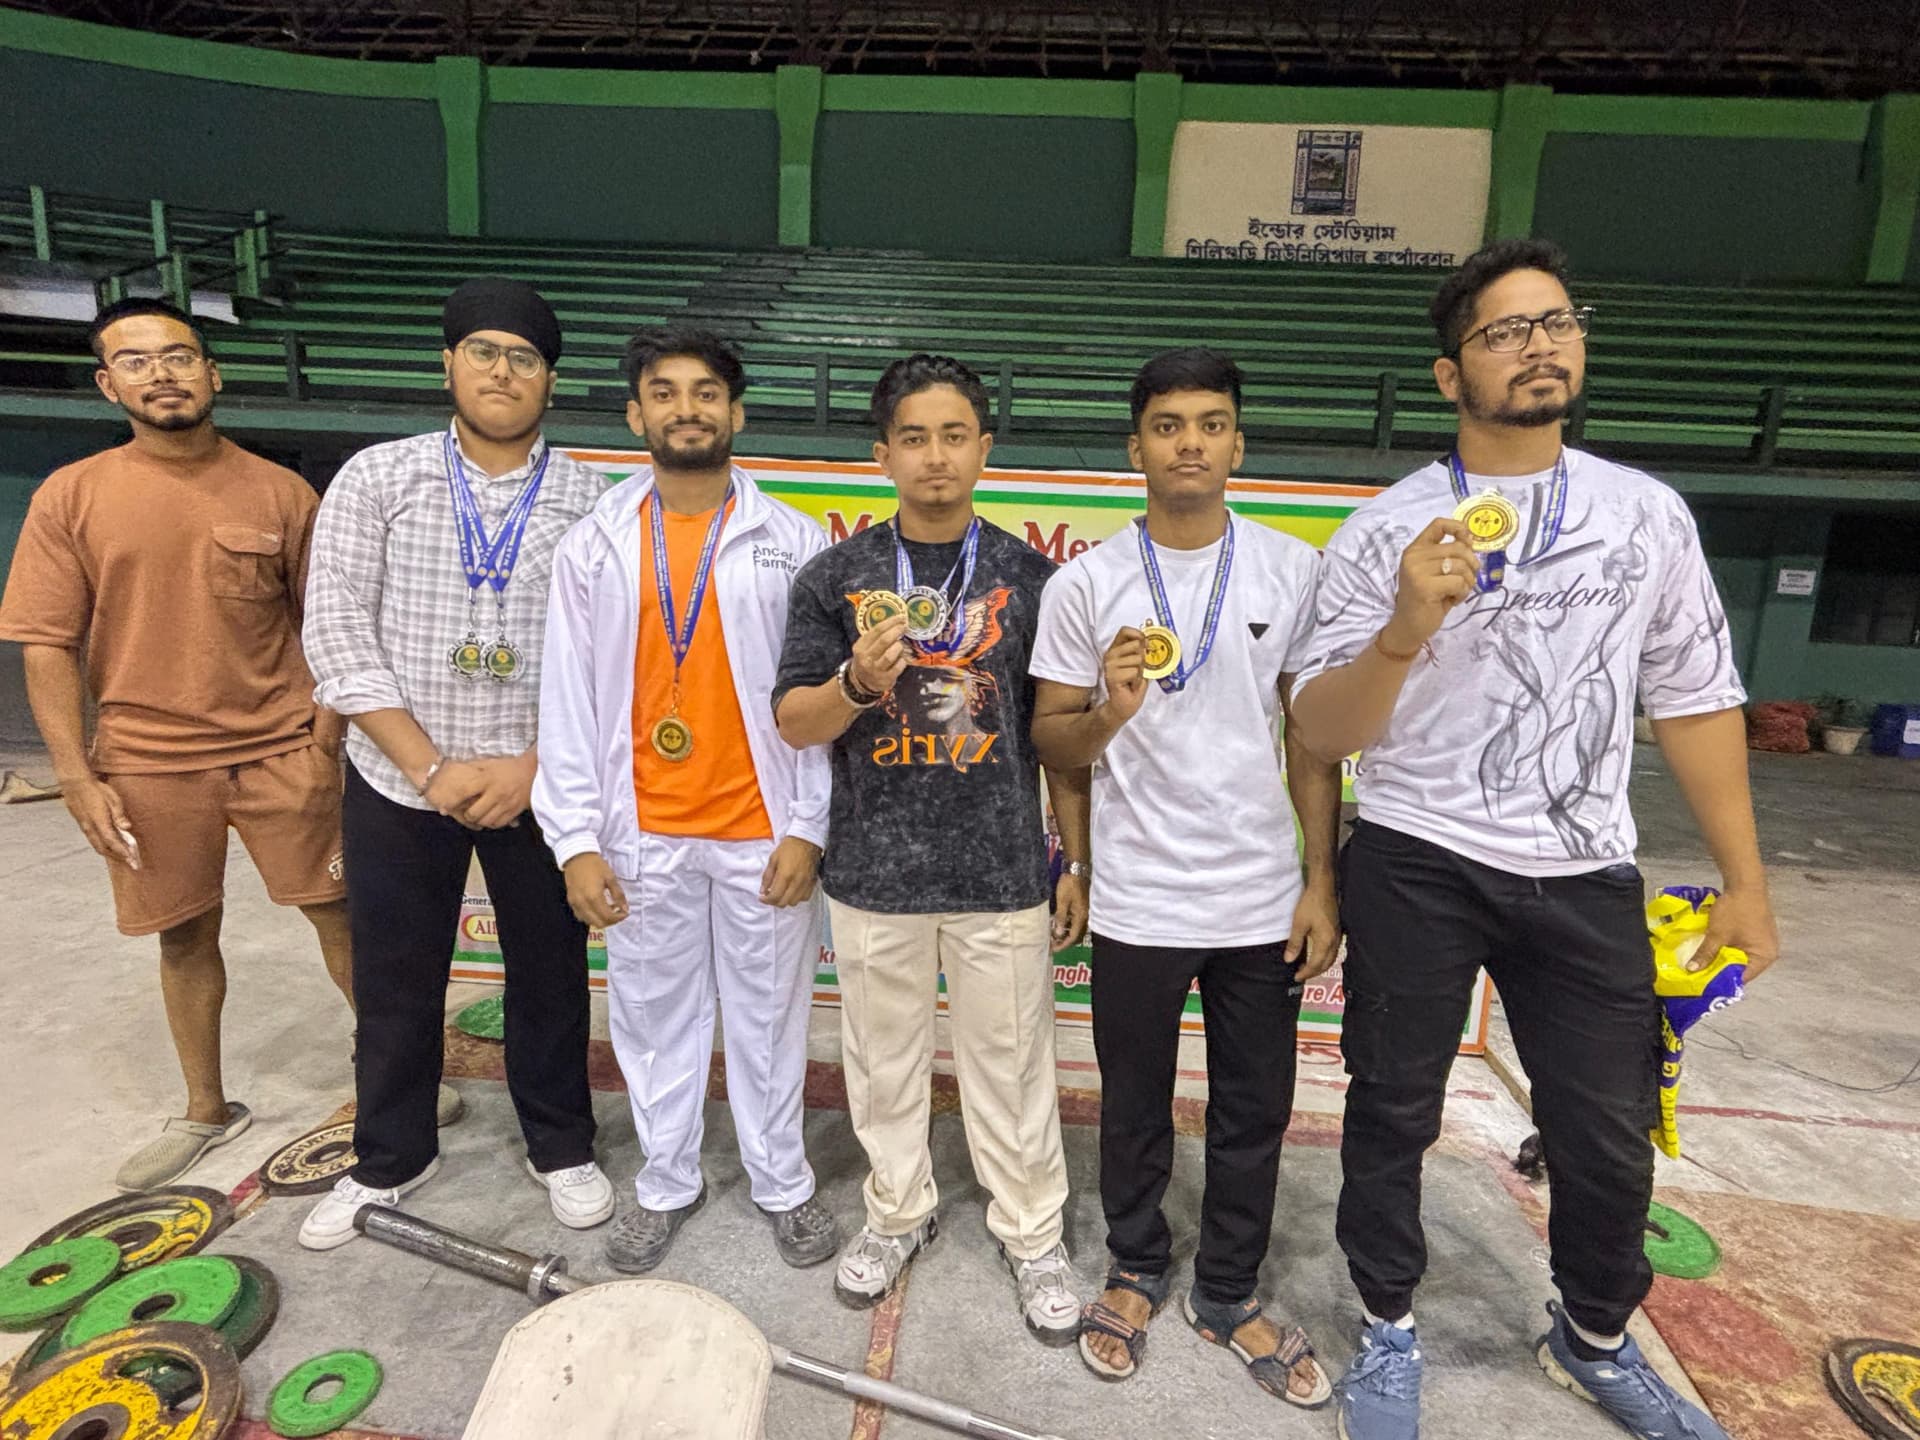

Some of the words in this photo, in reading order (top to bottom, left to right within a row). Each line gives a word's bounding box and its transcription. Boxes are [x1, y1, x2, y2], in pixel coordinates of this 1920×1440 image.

[1248, 216, 1305, 240] ইন্ডোর
[1314, 219, 1397, 243] স্টেডিয়াম
[1450, 572, 1622, 631] Freedom
